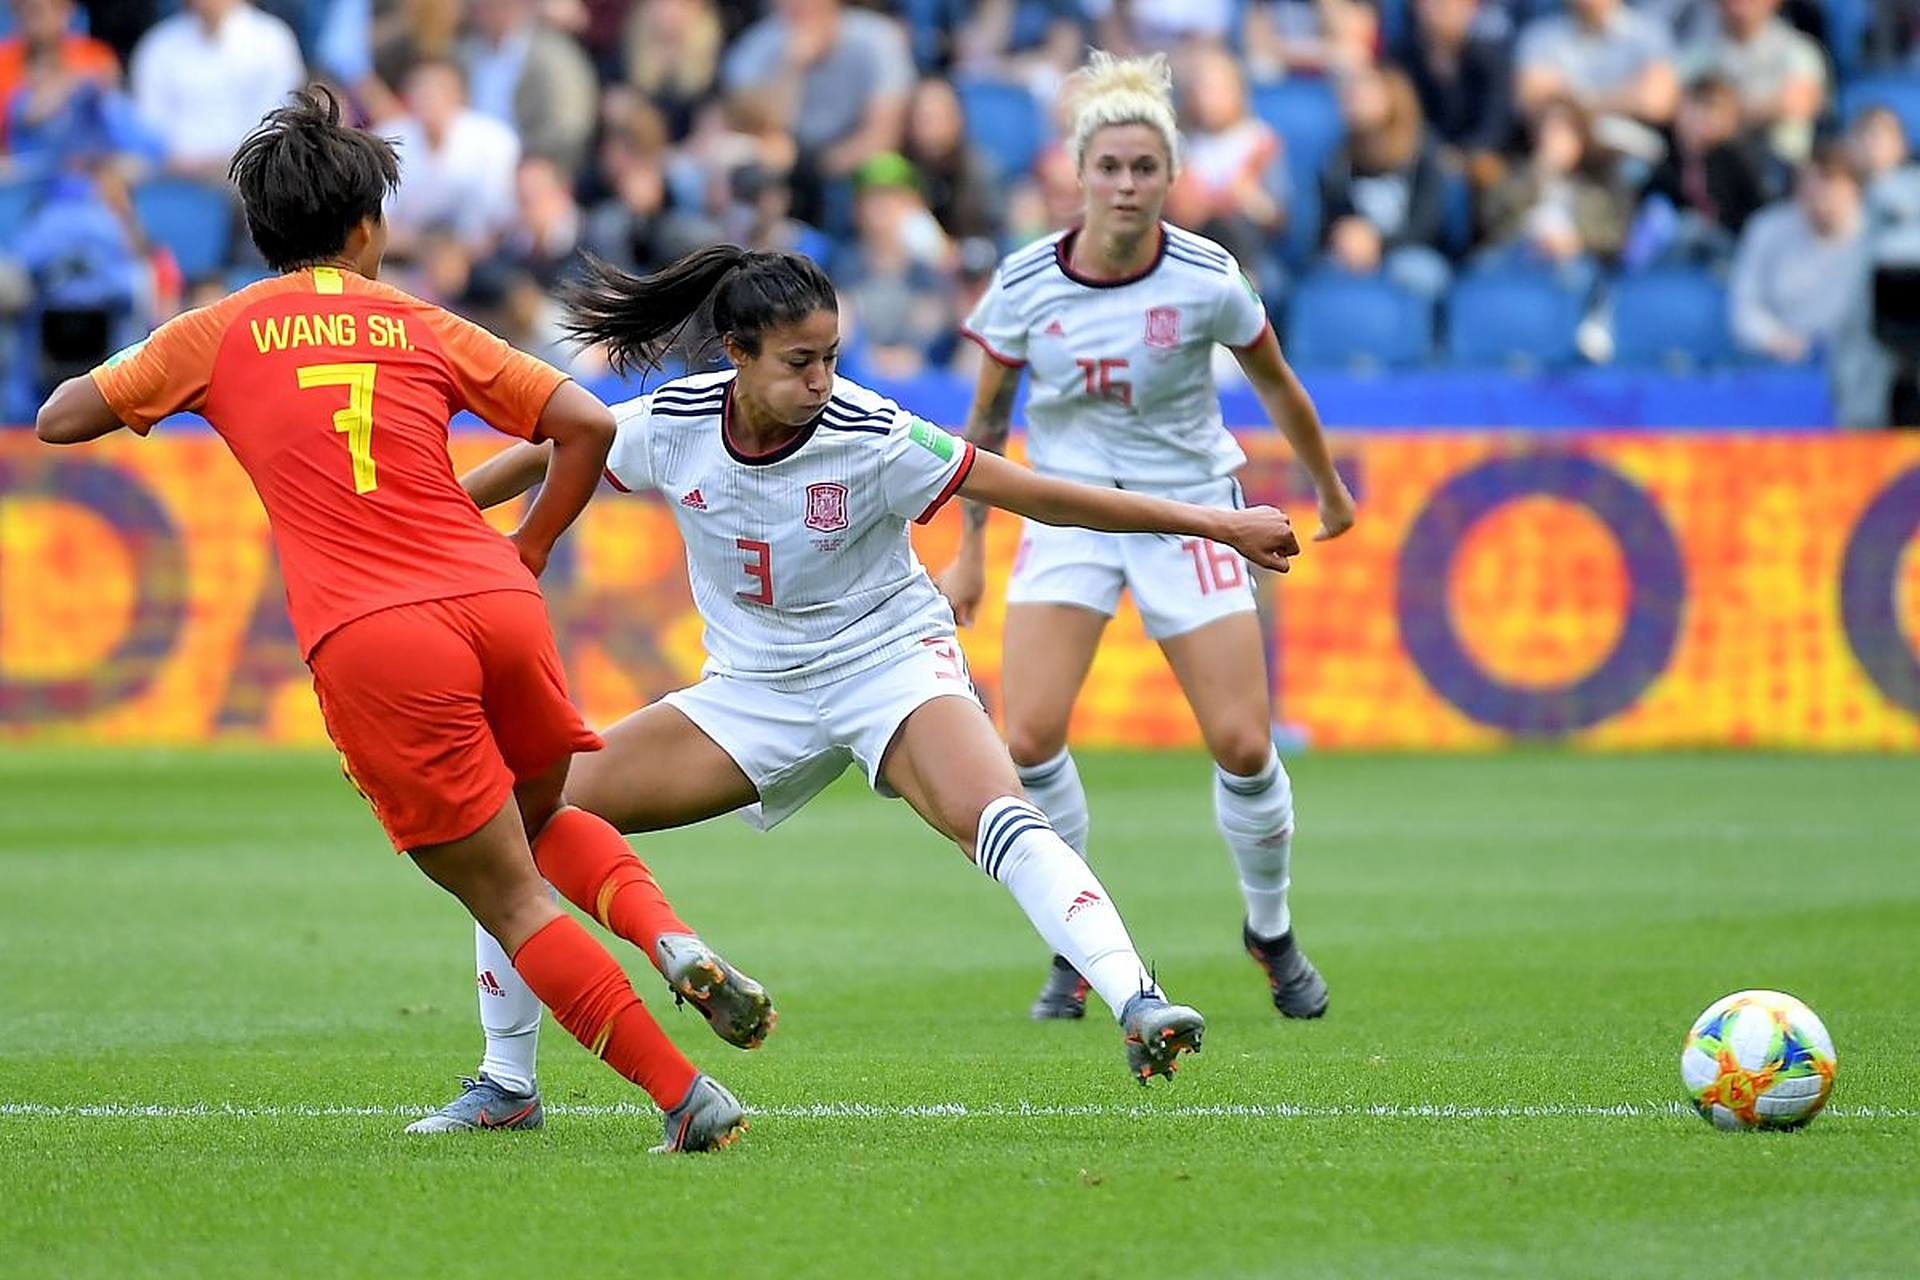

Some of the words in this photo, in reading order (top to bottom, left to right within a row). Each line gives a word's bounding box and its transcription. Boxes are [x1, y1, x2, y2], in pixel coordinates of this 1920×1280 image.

[250, 313, 357, 354] WANG
[367, 314, 415, 352] SH.
[1076, 358, 1132, 408] 16
[296, 363, 378, 496] 7
[736, 538, 774, 606] 3
[1182, 538, 1242, 596] 16
[921, 637, 963, 681] 3
